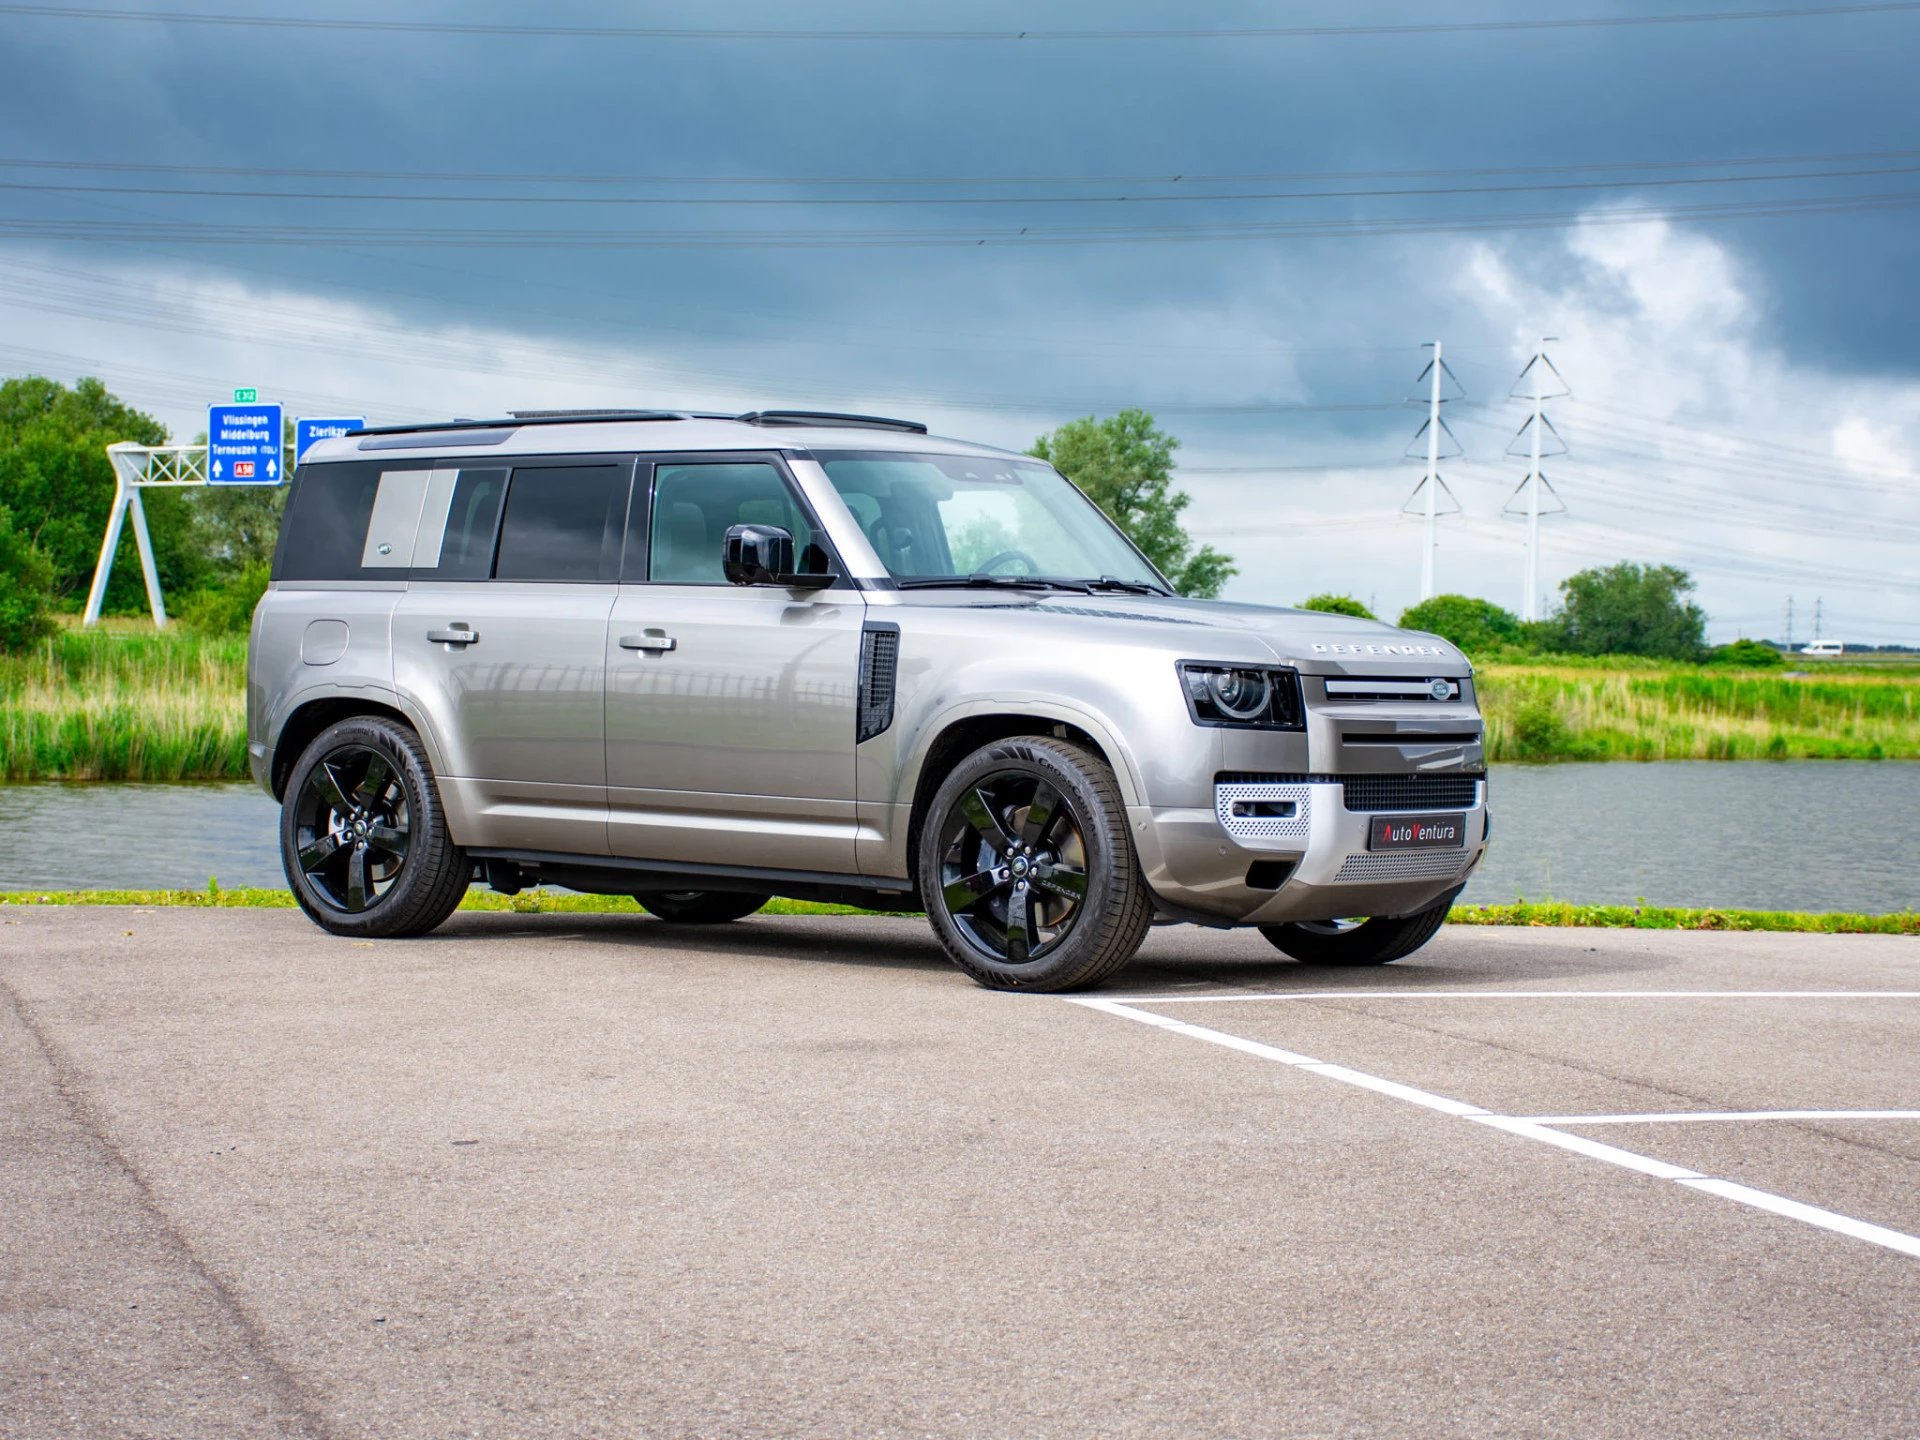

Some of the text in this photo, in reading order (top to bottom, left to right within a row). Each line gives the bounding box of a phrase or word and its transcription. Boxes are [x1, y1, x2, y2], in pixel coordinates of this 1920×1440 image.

[222, 414, 268, 428] Vlissingen
[220, 429, 270, 443] Middelburg
[309, 425, 351, 437] Zierikze
[212, 443, 257, 455] Terneuzen
[1311, 643, 1447, 657] DEFENDER
[1383, 823, 1455, 843] AutoVentura
